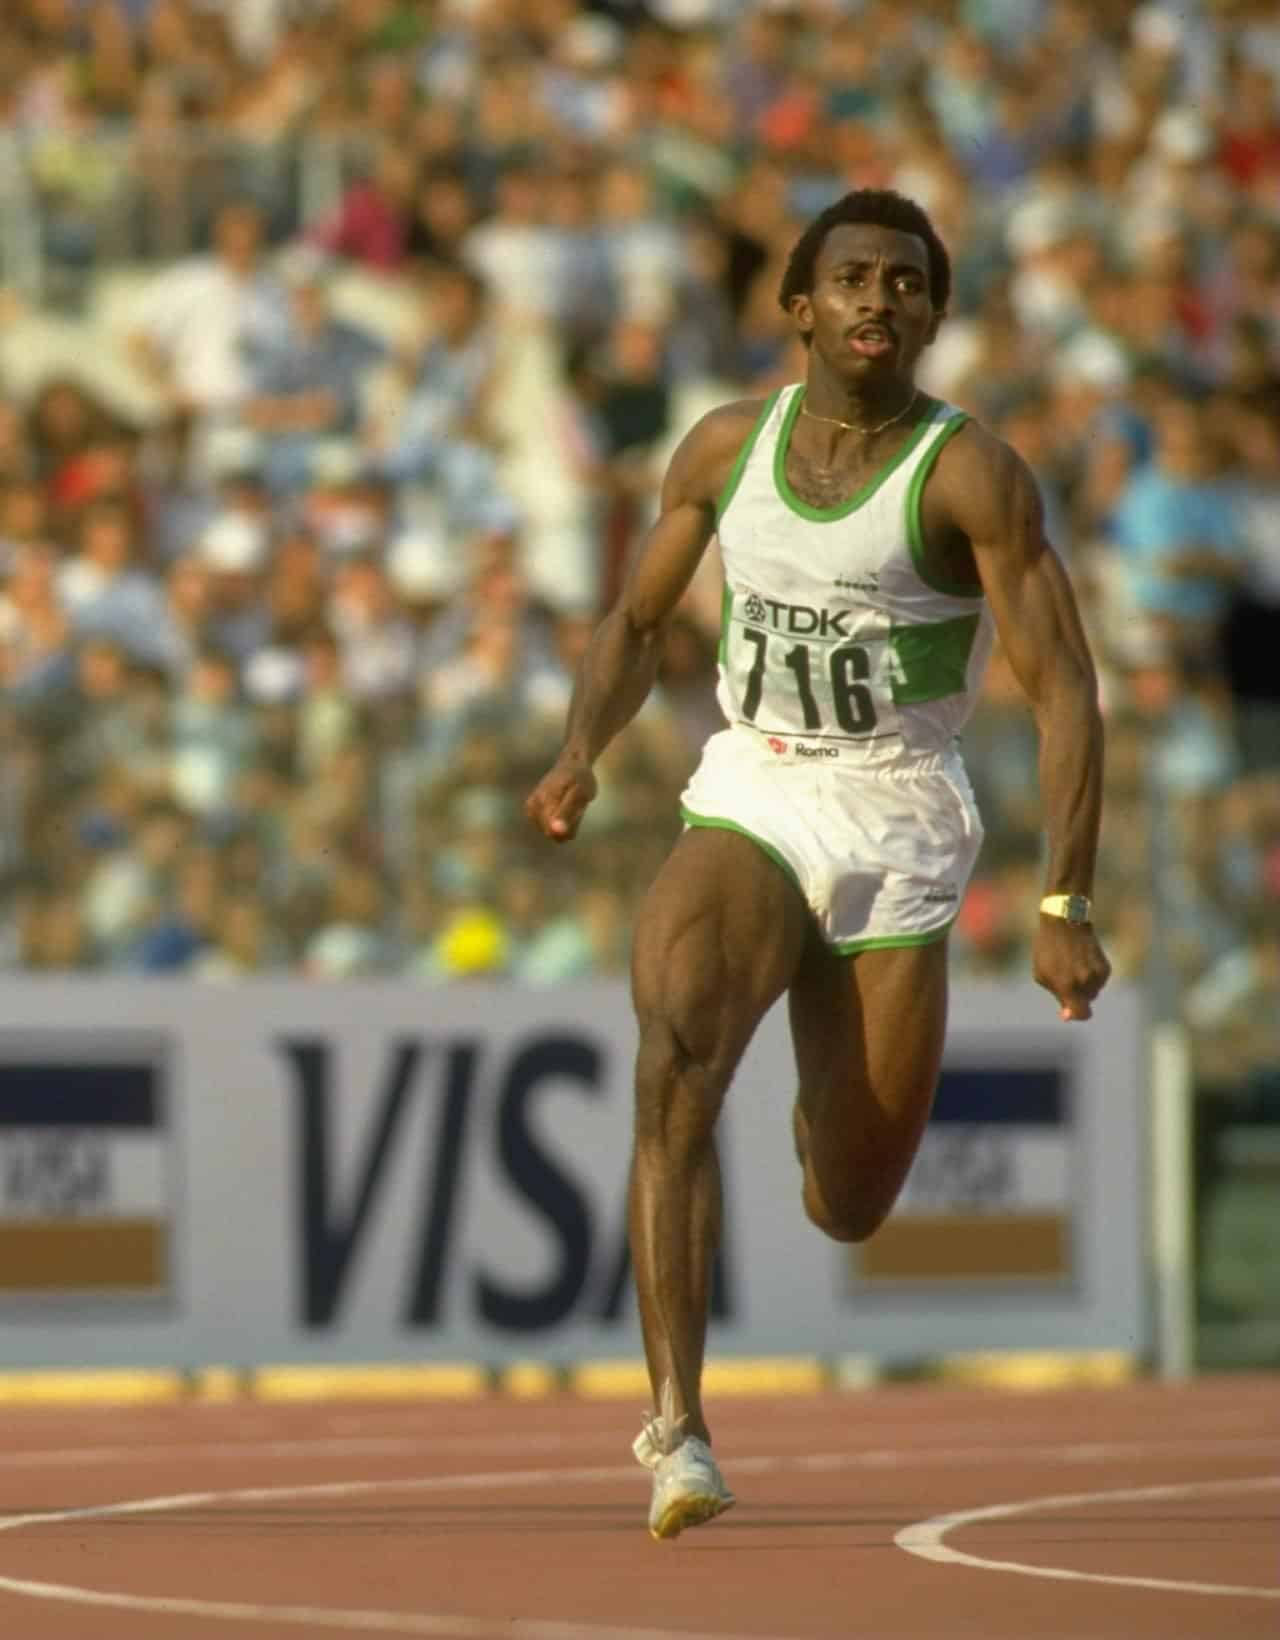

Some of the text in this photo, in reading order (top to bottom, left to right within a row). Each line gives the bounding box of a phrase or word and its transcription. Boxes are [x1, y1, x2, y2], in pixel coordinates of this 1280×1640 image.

[764, 603, 852, 637] TDK
[742, 628, 879, 734] 716
[795, 742, 838, 758] Roma
